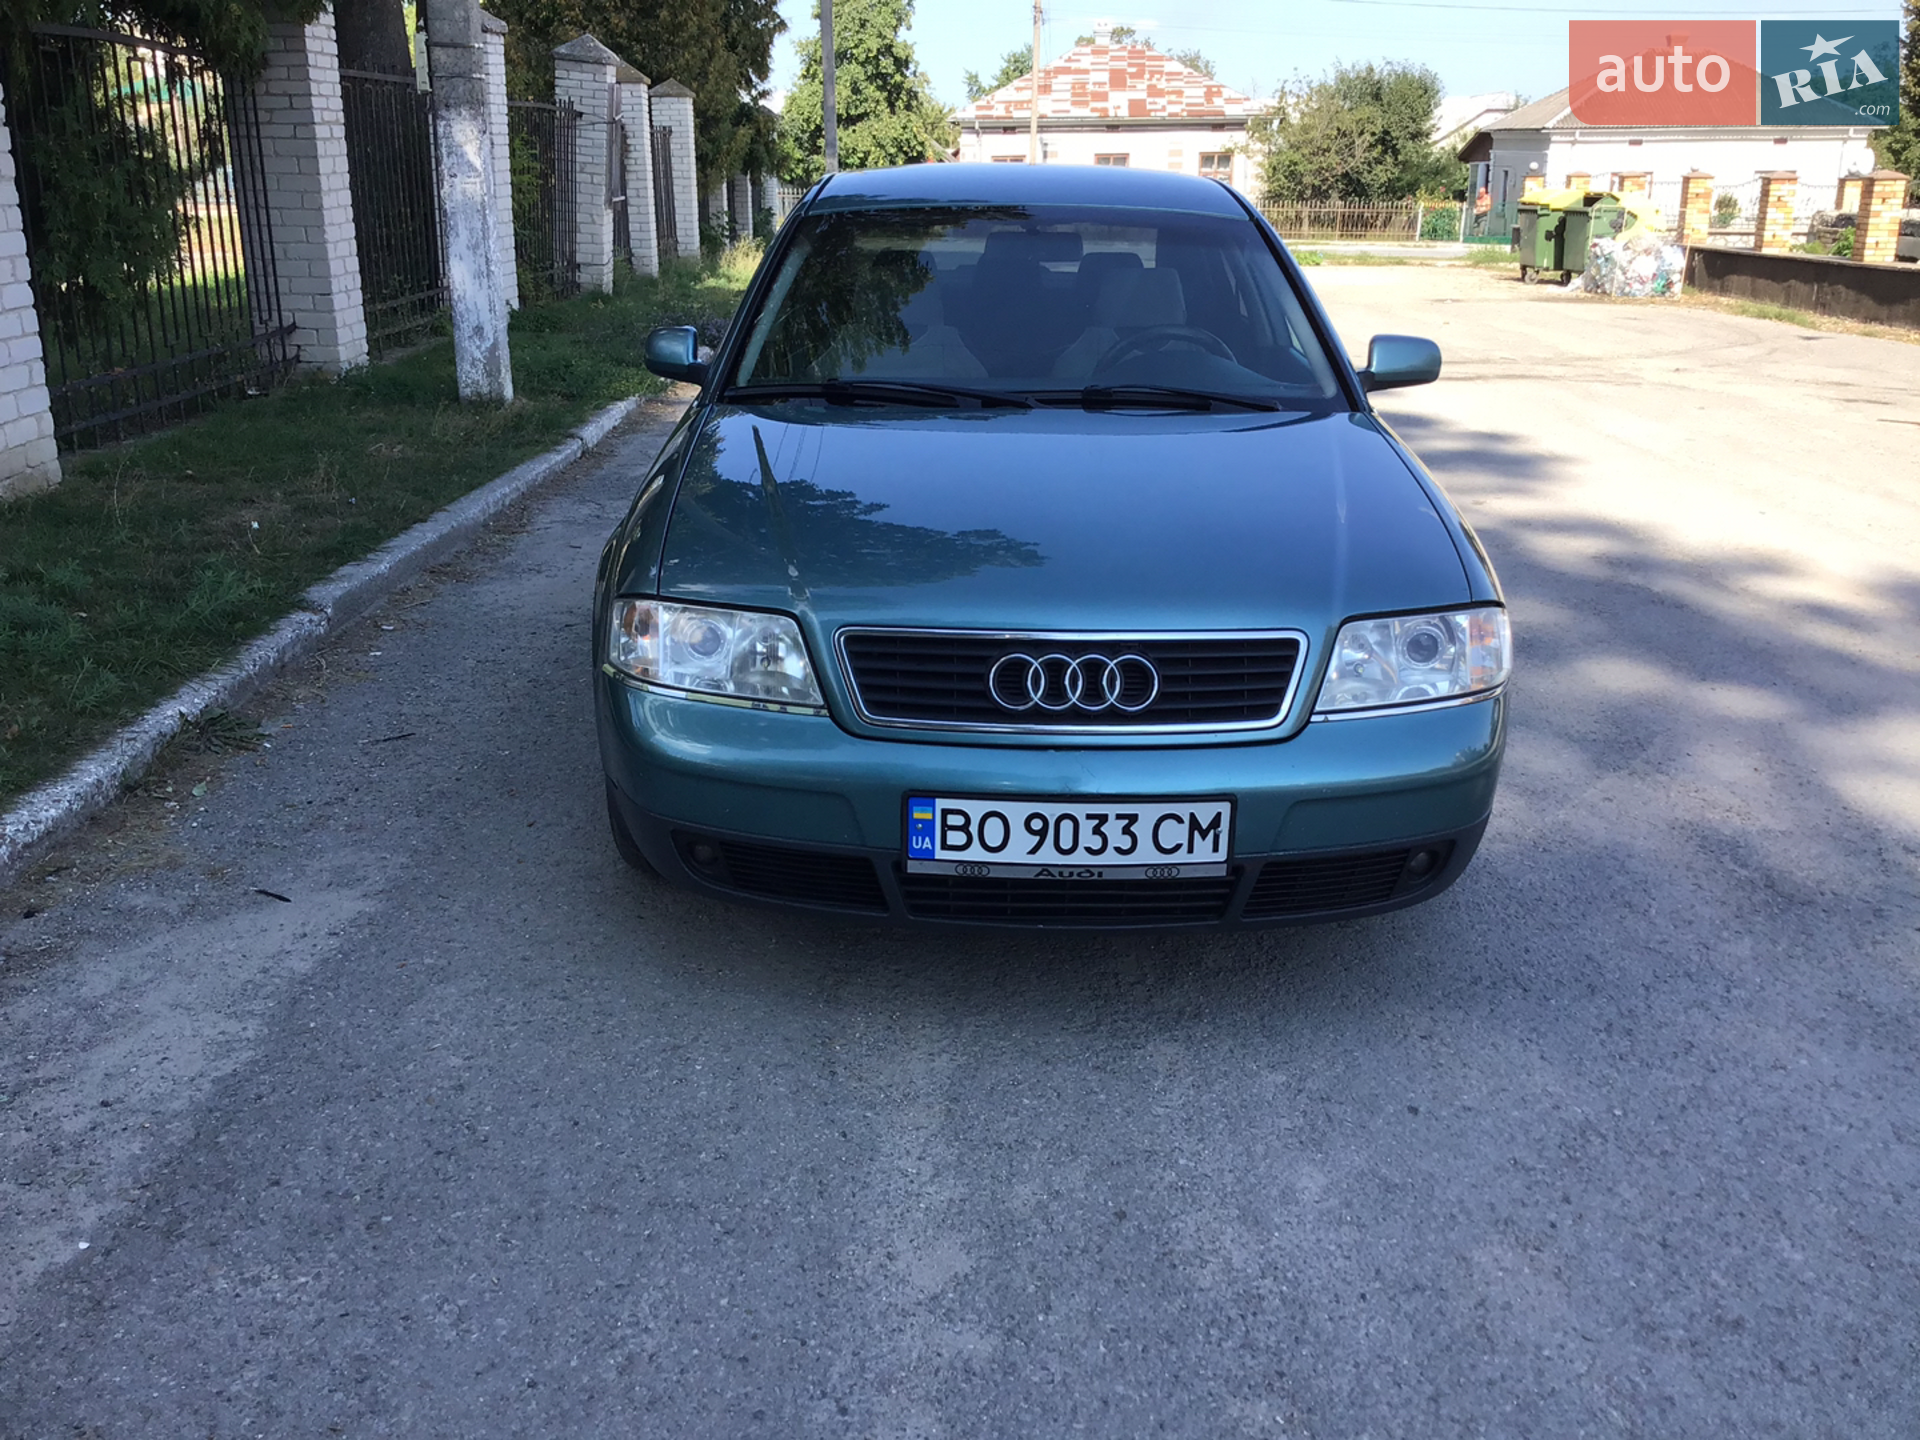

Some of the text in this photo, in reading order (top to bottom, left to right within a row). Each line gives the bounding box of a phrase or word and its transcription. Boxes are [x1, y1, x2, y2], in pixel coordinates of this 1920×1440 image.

[940, 808, 1223, 856] BO 9033 CM
[912, 836, 933, 850] UA
[1033, 867, 1104, 879] Audi
